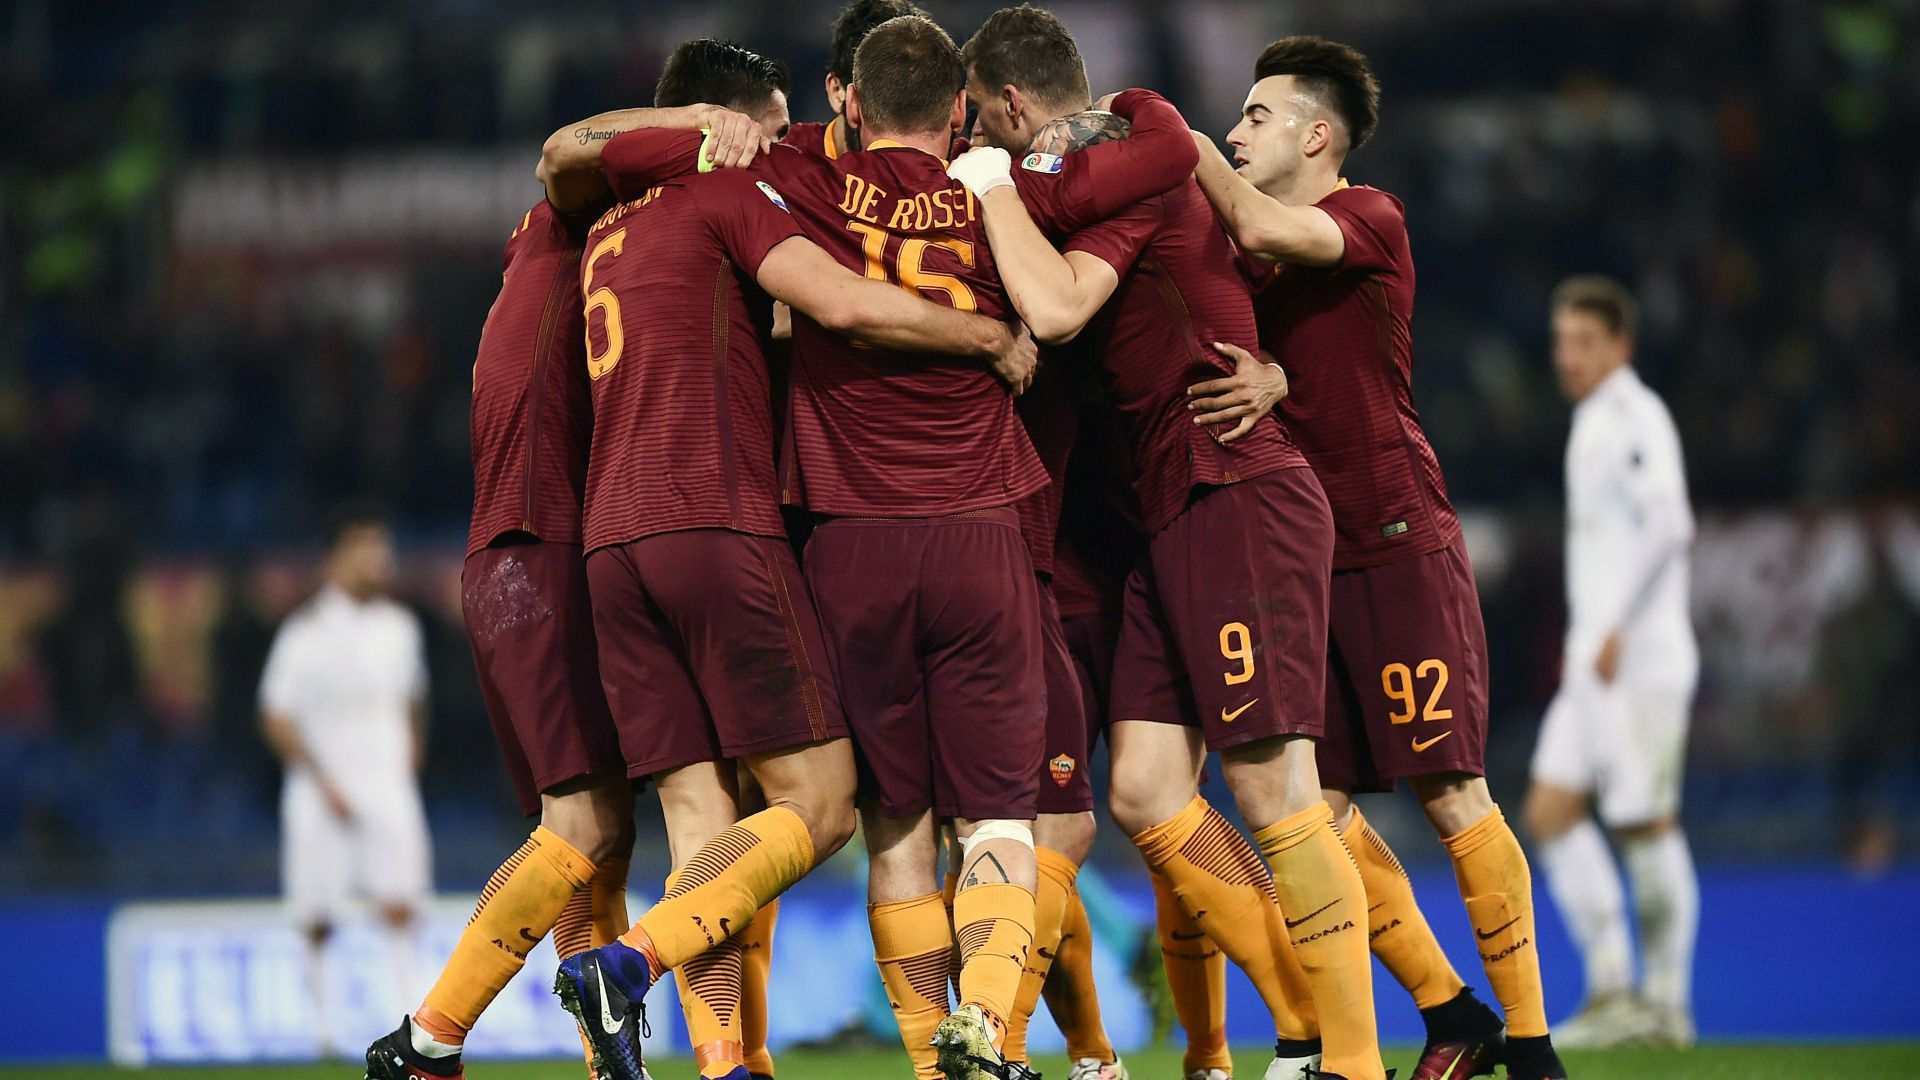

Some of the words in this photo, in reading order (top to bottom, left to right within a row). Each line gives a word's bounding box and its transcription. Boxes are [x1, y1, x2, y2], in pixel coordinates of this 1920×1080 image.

[838, 173, 887, 222] DE
[888, 185, 976, 230] ROSSI
[584, 227, 627, 381] 6
[846, 220, 977, 346] 16
[1219, 621, 1255, 686] 9
[1381, 659, 1453, 725] 92
